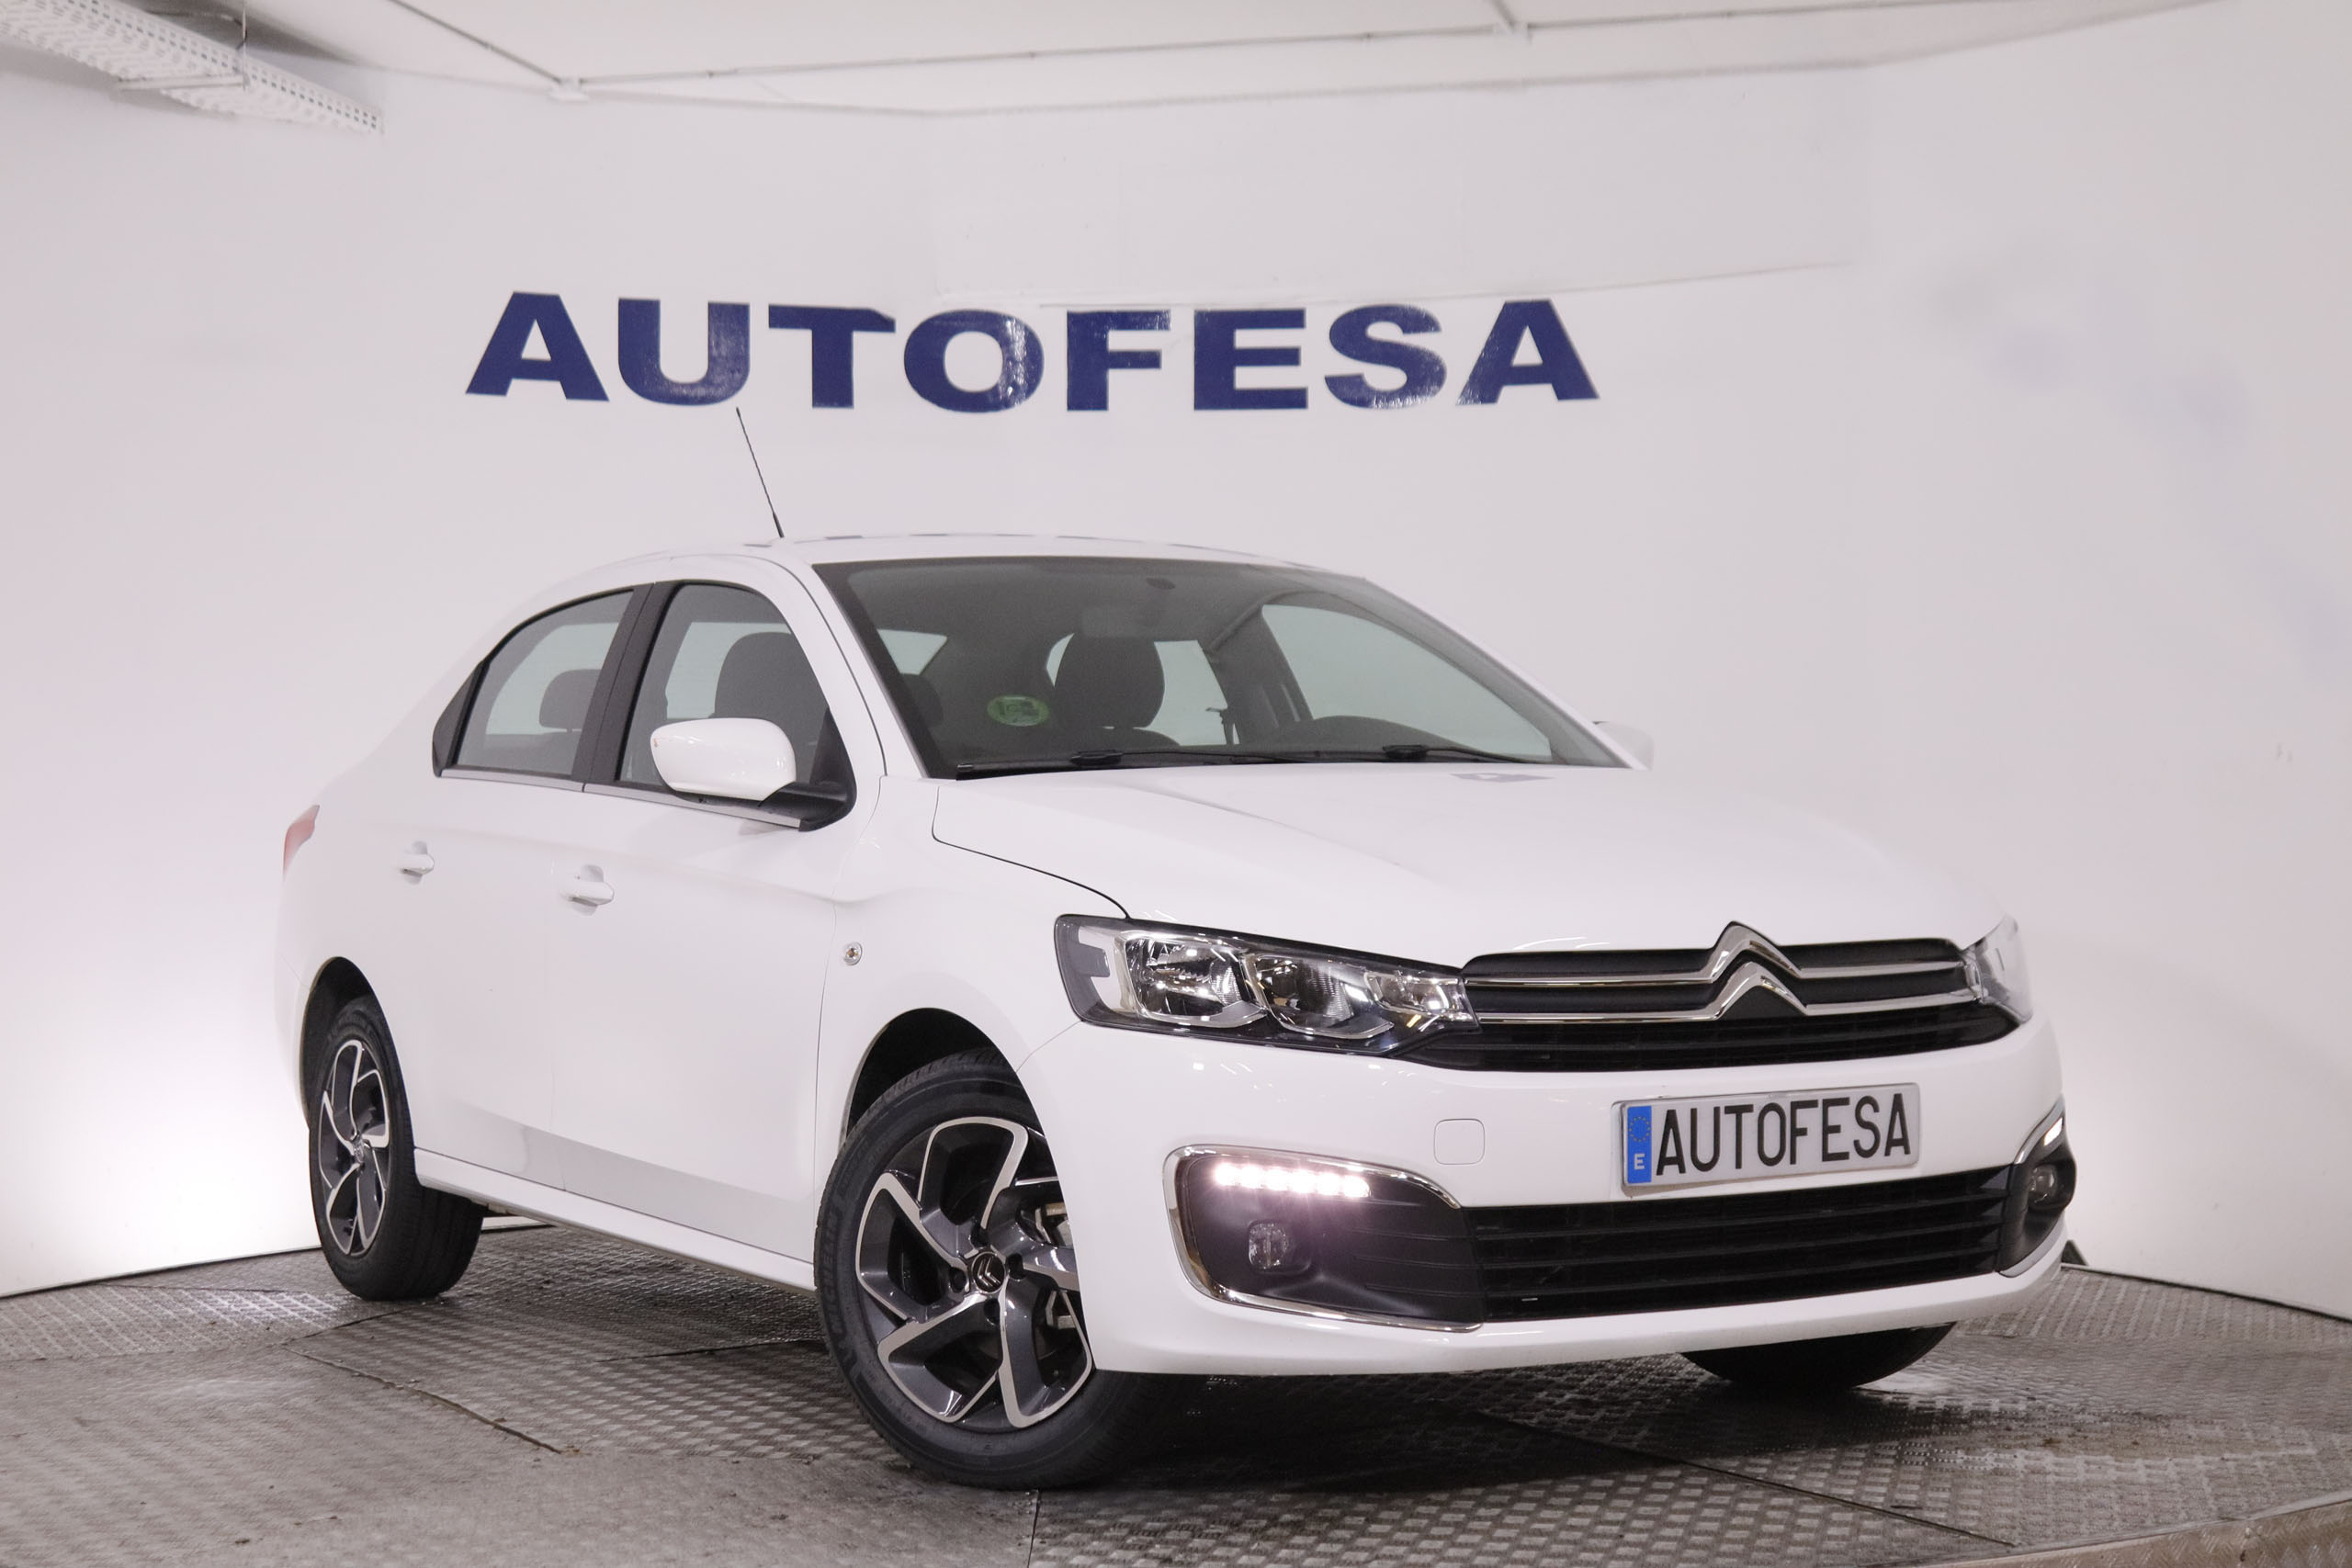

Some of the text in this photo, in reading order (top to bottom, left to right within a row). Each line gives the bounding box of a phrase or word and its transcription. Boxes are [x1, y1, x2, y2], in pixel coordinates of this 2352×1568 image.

[465, 291, 1599, 412] AUTOFESA
[1634, 1153, 1645, 1170] E
[1656, 1093, 1911, 1176] AUTOFESA
